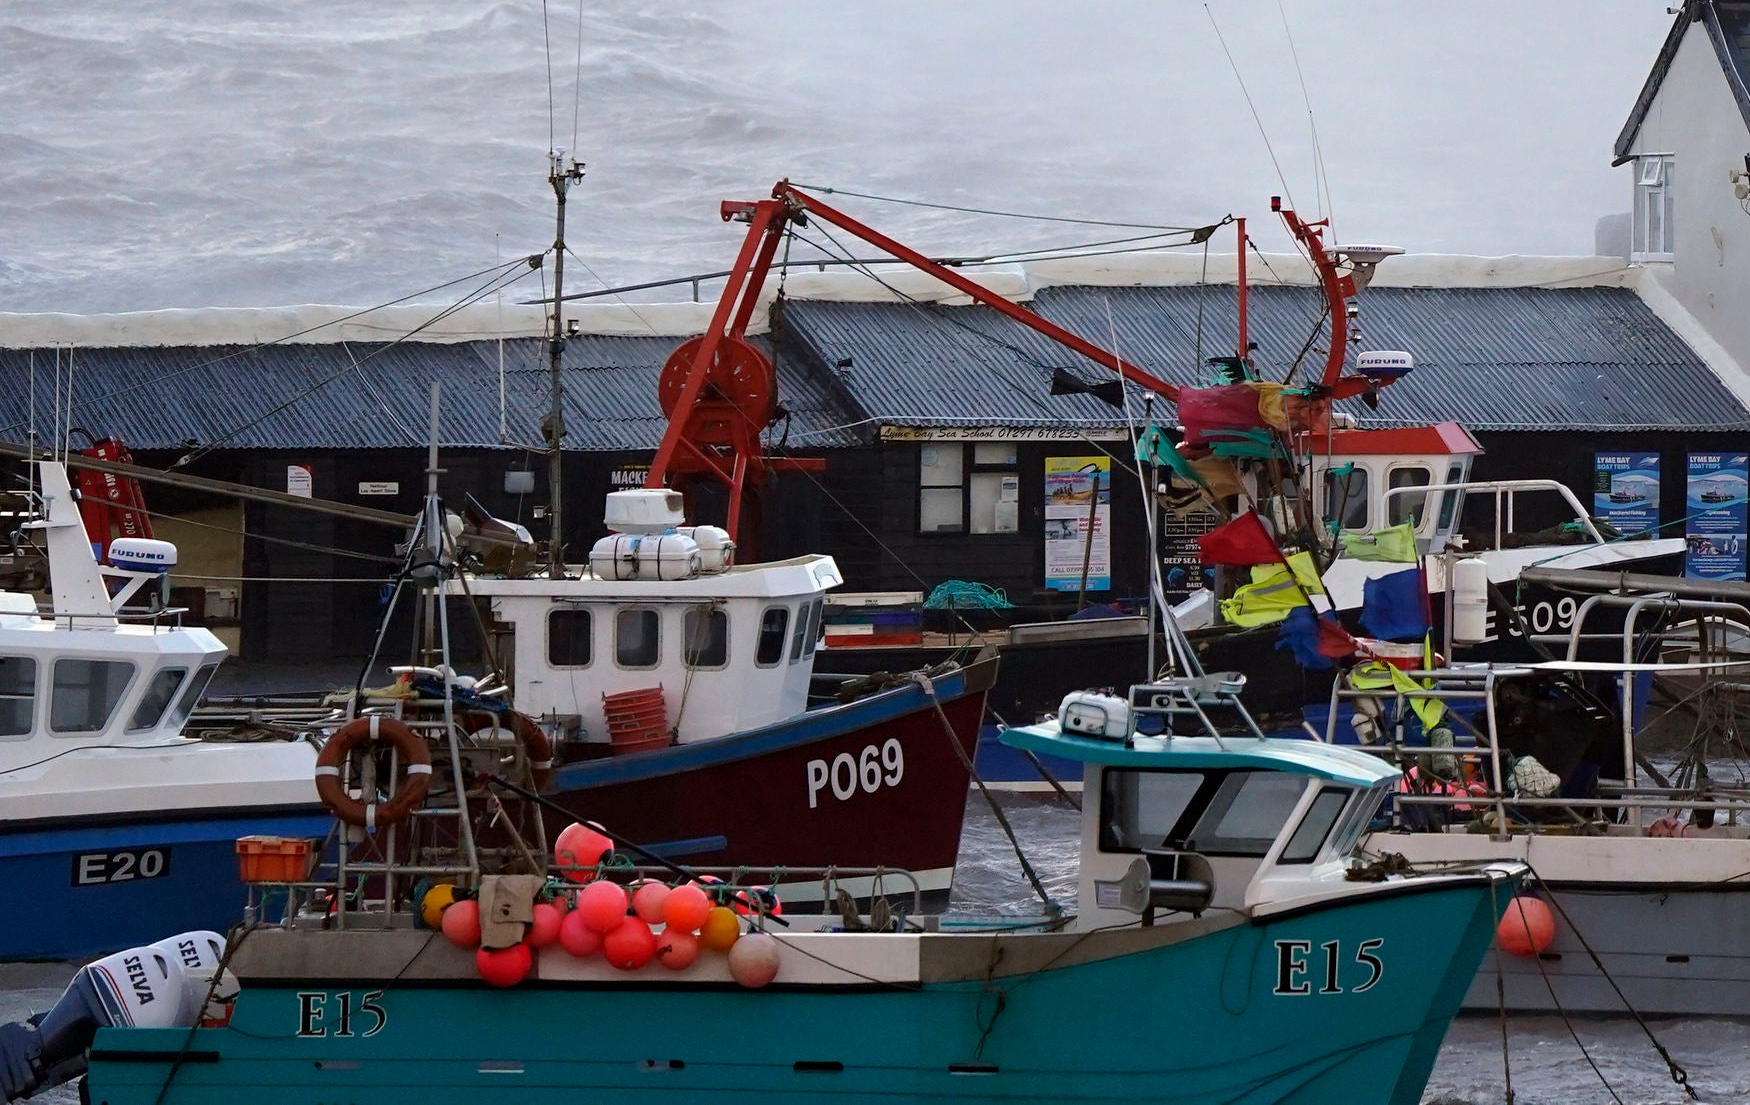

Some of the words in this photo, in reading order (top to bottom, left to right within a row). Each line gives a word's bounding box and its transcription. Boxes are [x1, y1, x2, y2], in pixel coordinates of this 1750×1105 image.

[881, 428, 909, 438] Lyme
[938, 428, 957, 438] Sea
[961, 428, 995, 438] School
[998, 429, 1034, 438] 01297
[112, 549, 165, 560] FURUNO
[807, 738, 904, 809] PO69
[79, 850, 163, 884] E20
[123, 955, 155, 1006] SELVA
[1273, 937, 1384, 996] E15
[296, 989, 387, 1038] E15
